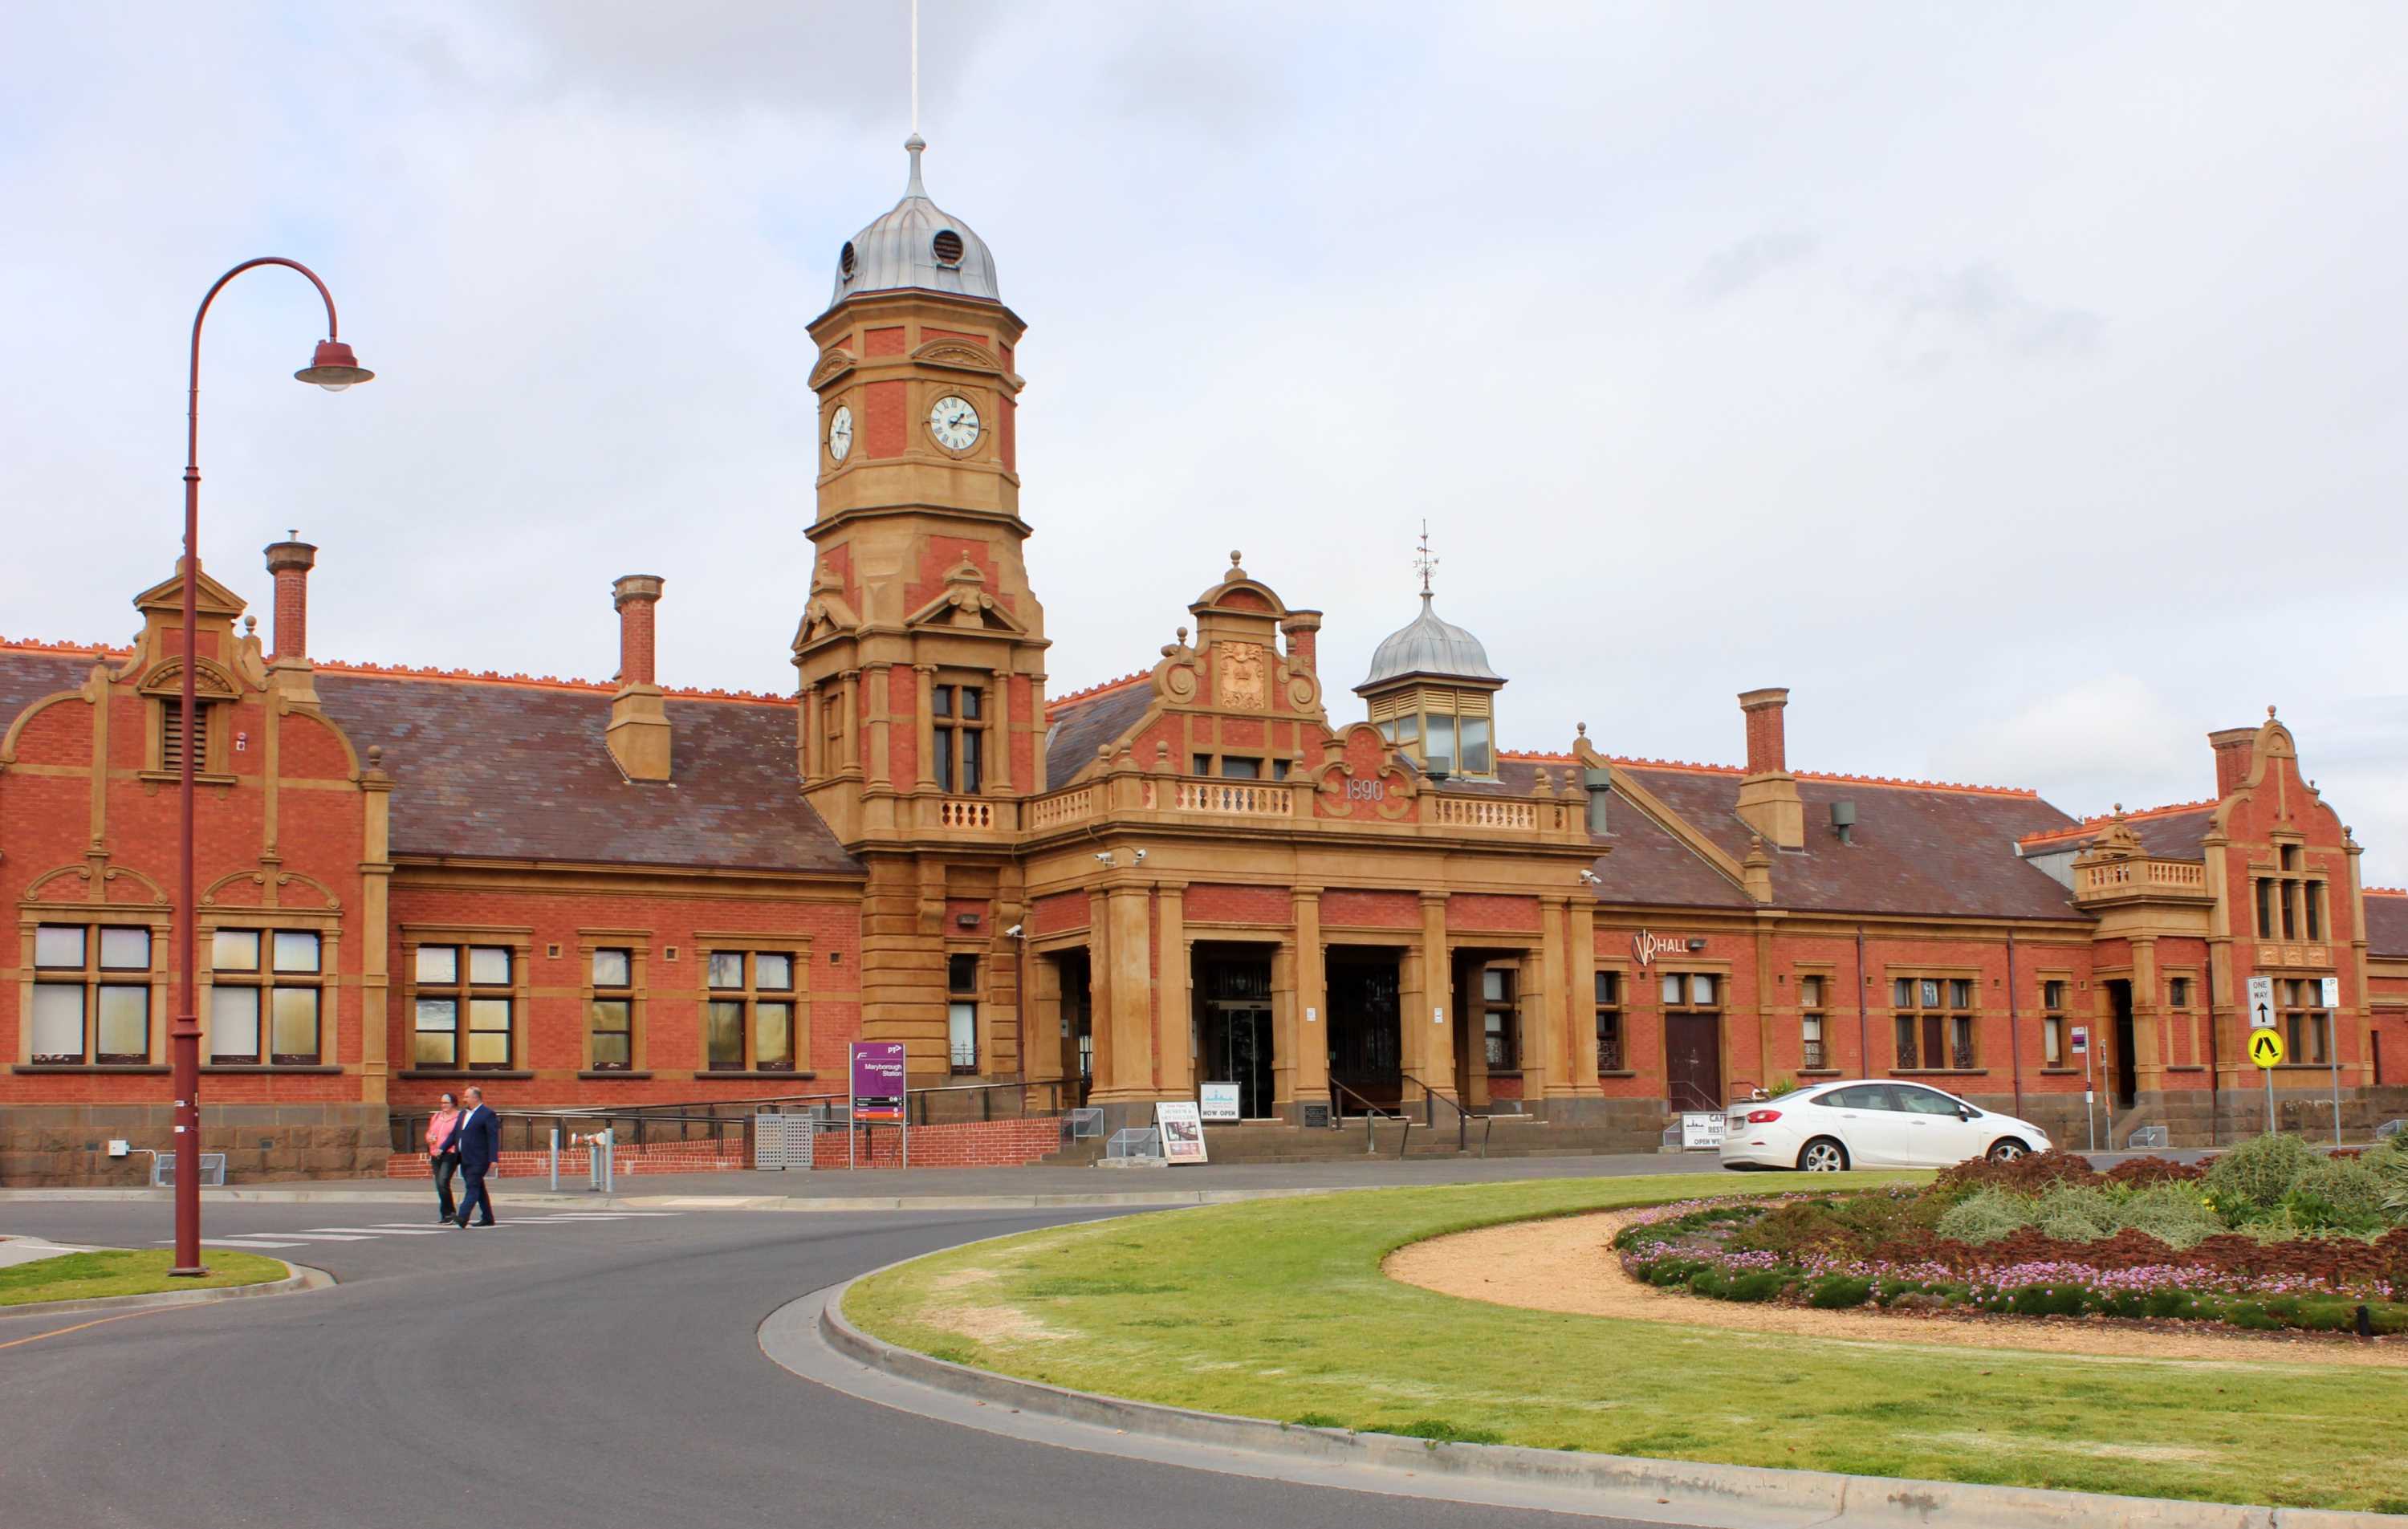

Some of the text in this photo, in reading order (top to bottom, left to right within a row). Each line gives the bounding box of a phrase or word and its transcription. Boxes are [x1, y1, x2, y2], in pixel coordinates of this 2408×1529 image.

[1346, 779, 1384, 801] 1890
[1657, 937, 1690, 953] HALL
[2252, 980, 2268, 989] ONE
[2254, 990, 2268, 999] WAY
[864, 1063, 902, 1072] Maryborough
